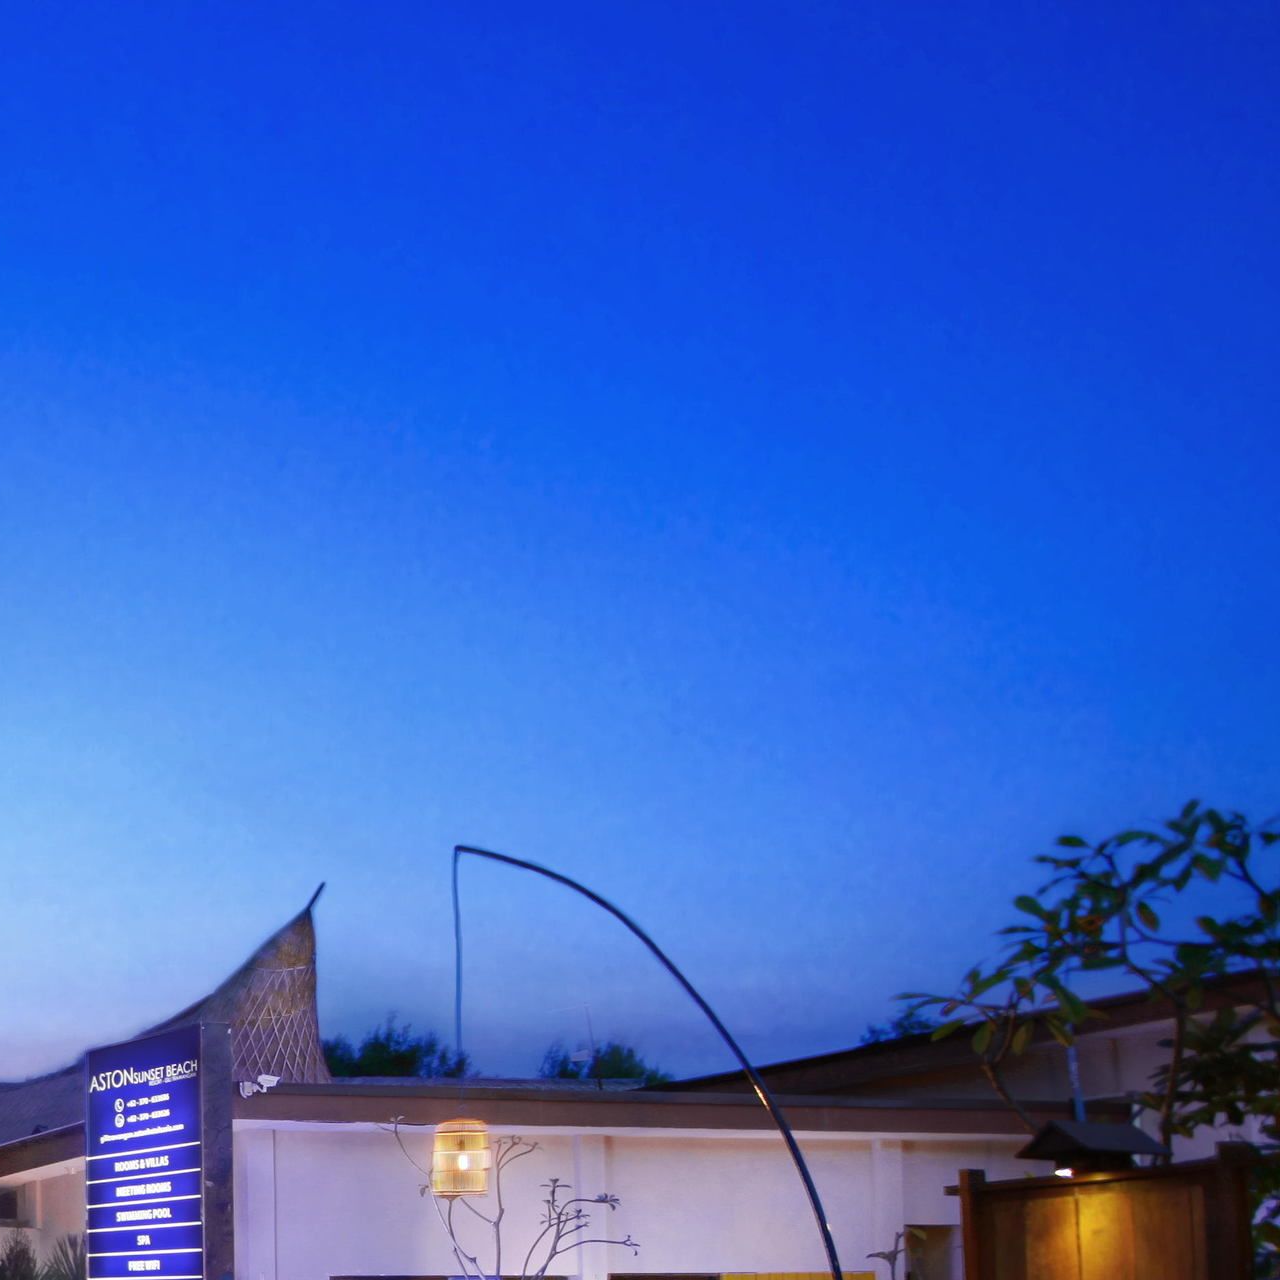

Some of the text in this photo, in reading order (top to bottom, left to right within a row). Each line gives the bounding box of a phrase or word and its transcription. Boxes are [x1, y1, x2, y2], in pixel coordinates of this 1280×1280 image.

[89, 1067, 134, 1093] ASTON
[133, 1067, 165, 1084] SUNSET
[166, 1060, 198, 1078] BEACH
[115, 1160, 139, 1172] ROOMS
[145, 1156, 169, 1168] VILLAS
[152, 1208, 172, 1219] POOL
[137, 1235, 151, 1245] SPA
